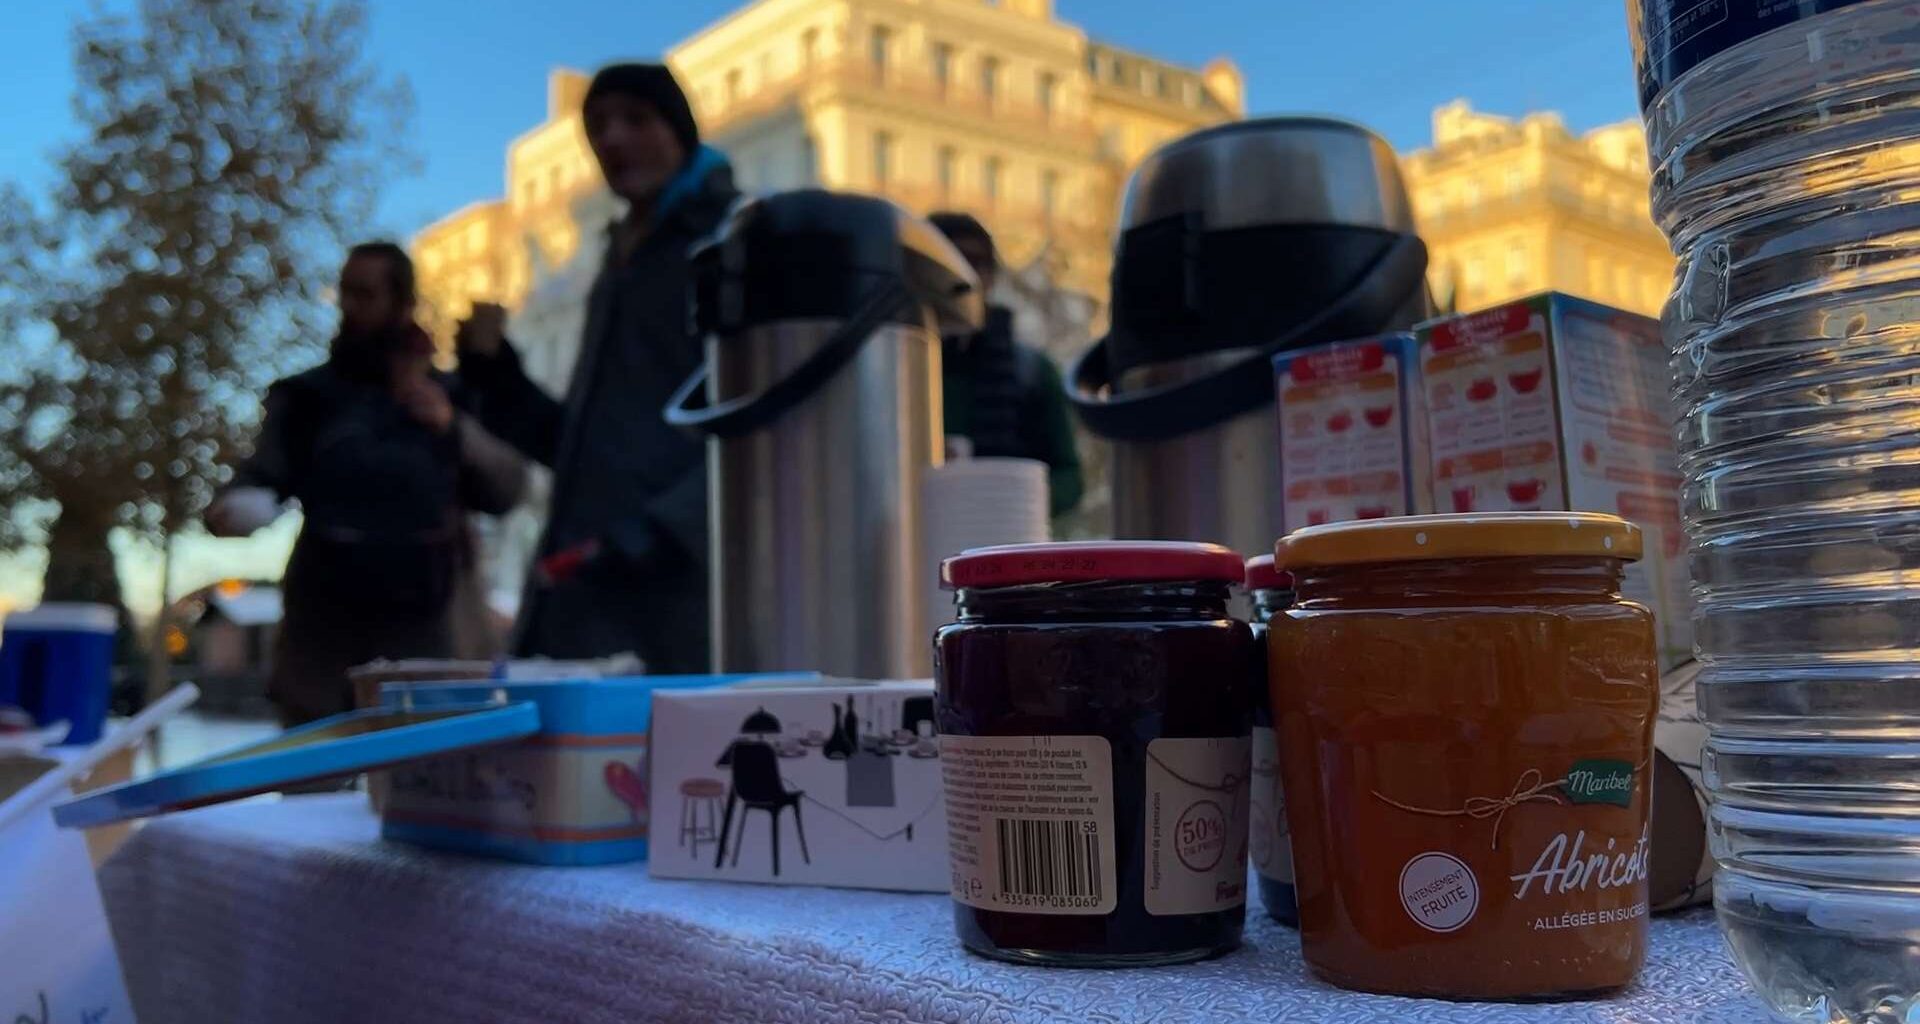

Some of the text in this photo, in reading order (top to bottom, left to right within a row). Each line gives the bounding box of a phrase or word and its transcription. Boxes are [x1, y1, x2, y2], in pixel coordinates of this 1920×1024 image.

[1567, 769, 1633, 796] Maribel
[1082, 820, 1097, 833] 58
[1051, 896, 1099, 908] 085060
[1421, 883, 1469, 917] FRUITÉ
[1534, 909, 1597, 930] ALLÉGÉE
[1599, 909, 1615, 924] EN
